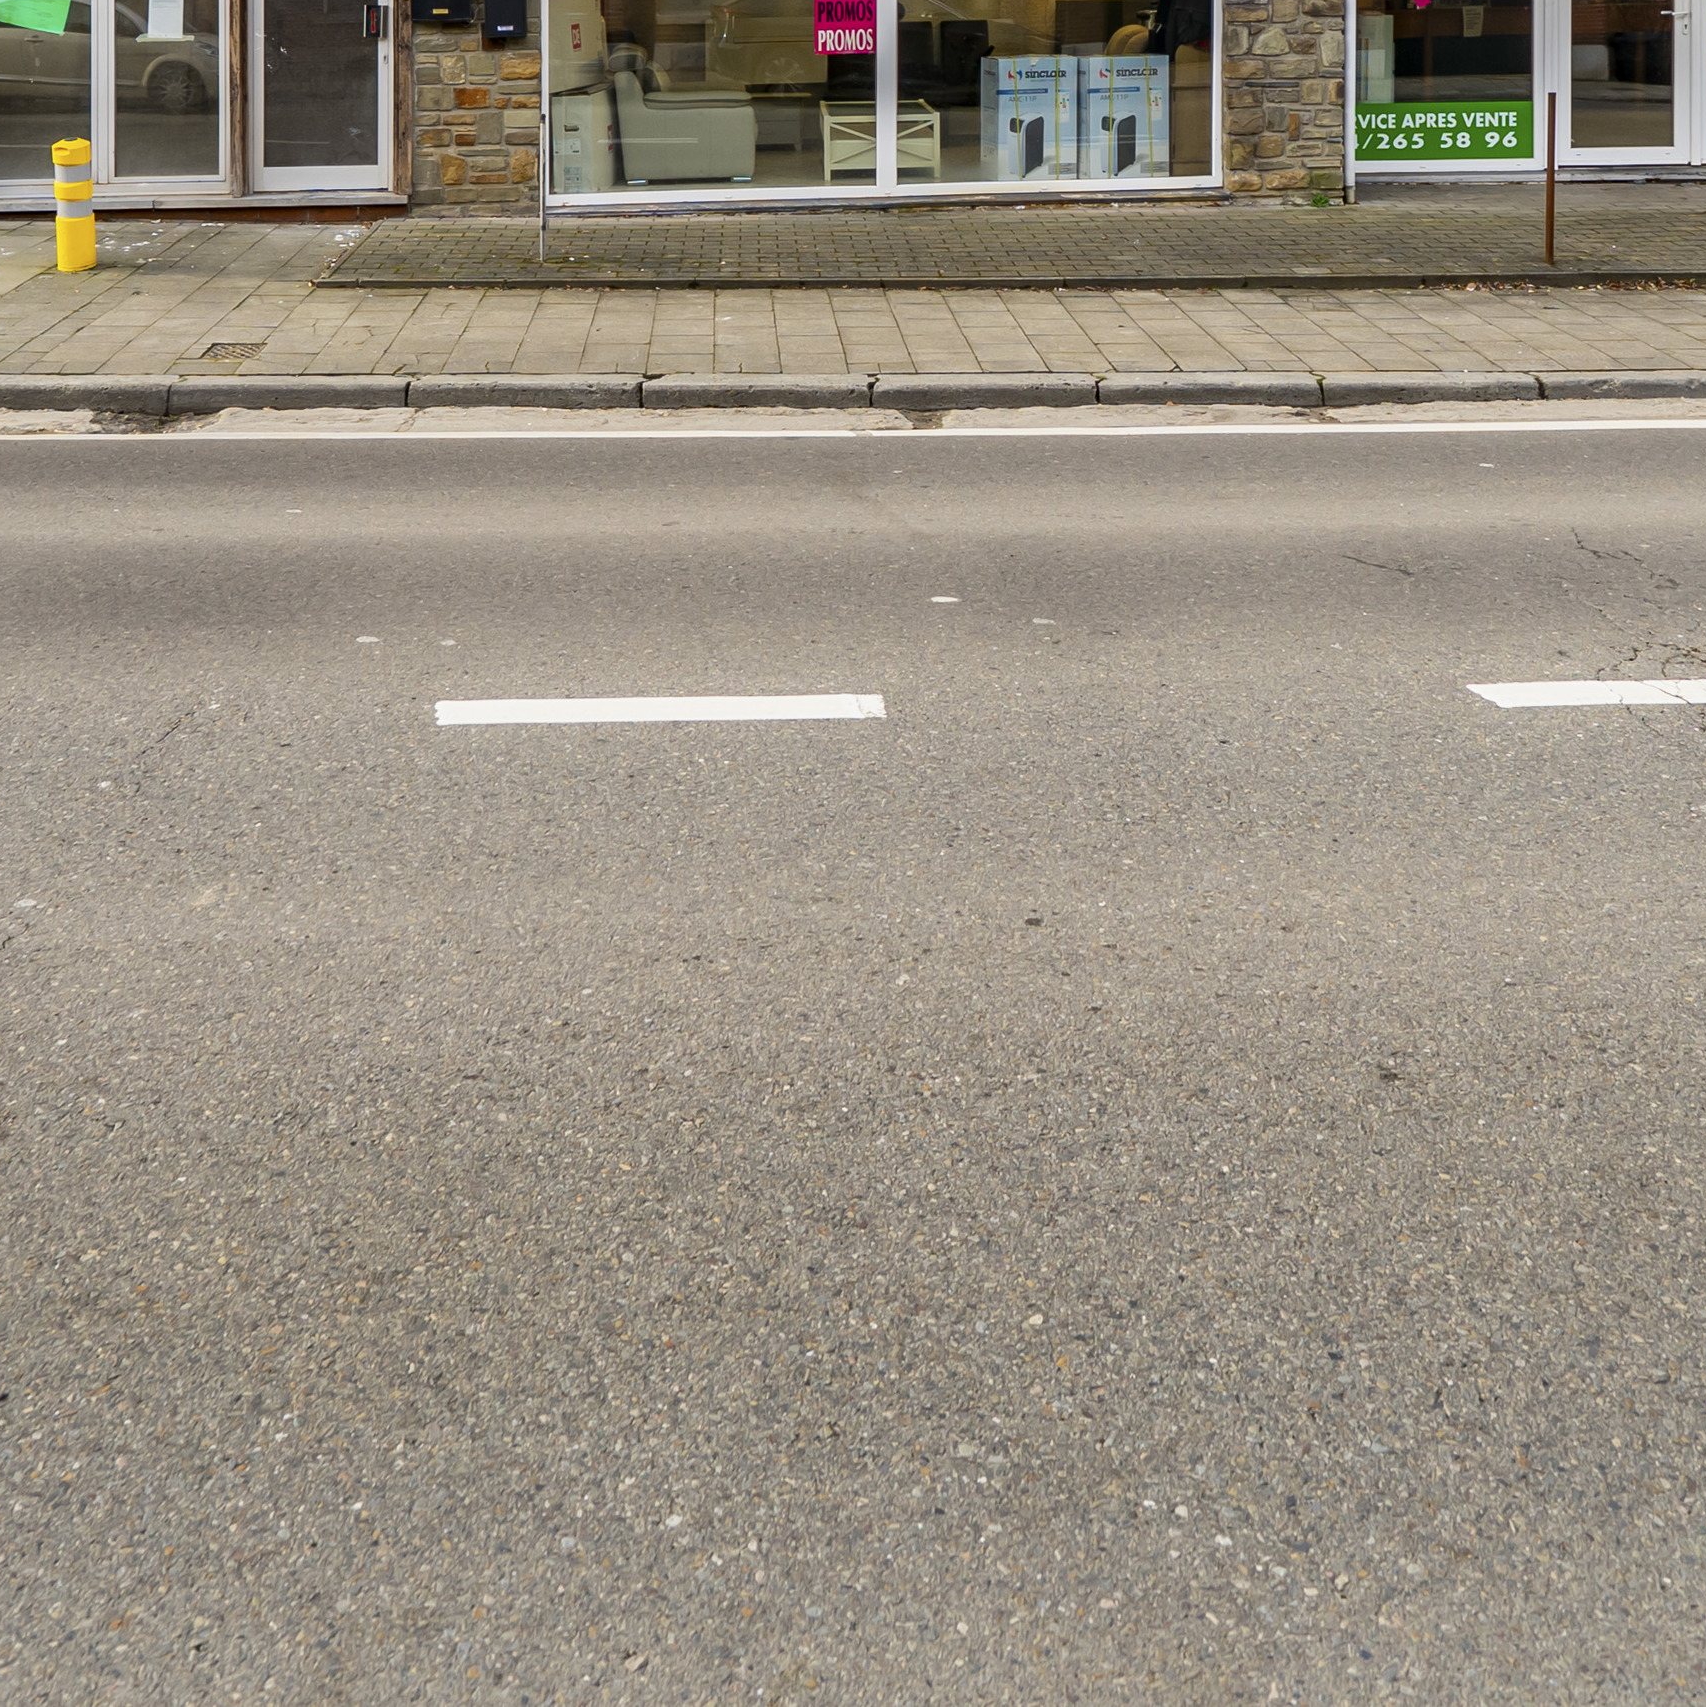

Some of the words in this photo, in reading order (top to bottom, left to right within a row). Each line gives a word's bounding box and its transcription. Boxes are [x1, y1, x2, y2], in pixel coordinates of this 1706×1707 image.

[816, 0, 874, 23] PROMOS
[816, 28, 874, 52] PROMOS
[1401, 112, 1457, 129] APRES
[1462, 112, 1518, 128] VENTE
[1440, 132, 1472, 149] 58
[1484, 131, 1518, 148] 96
